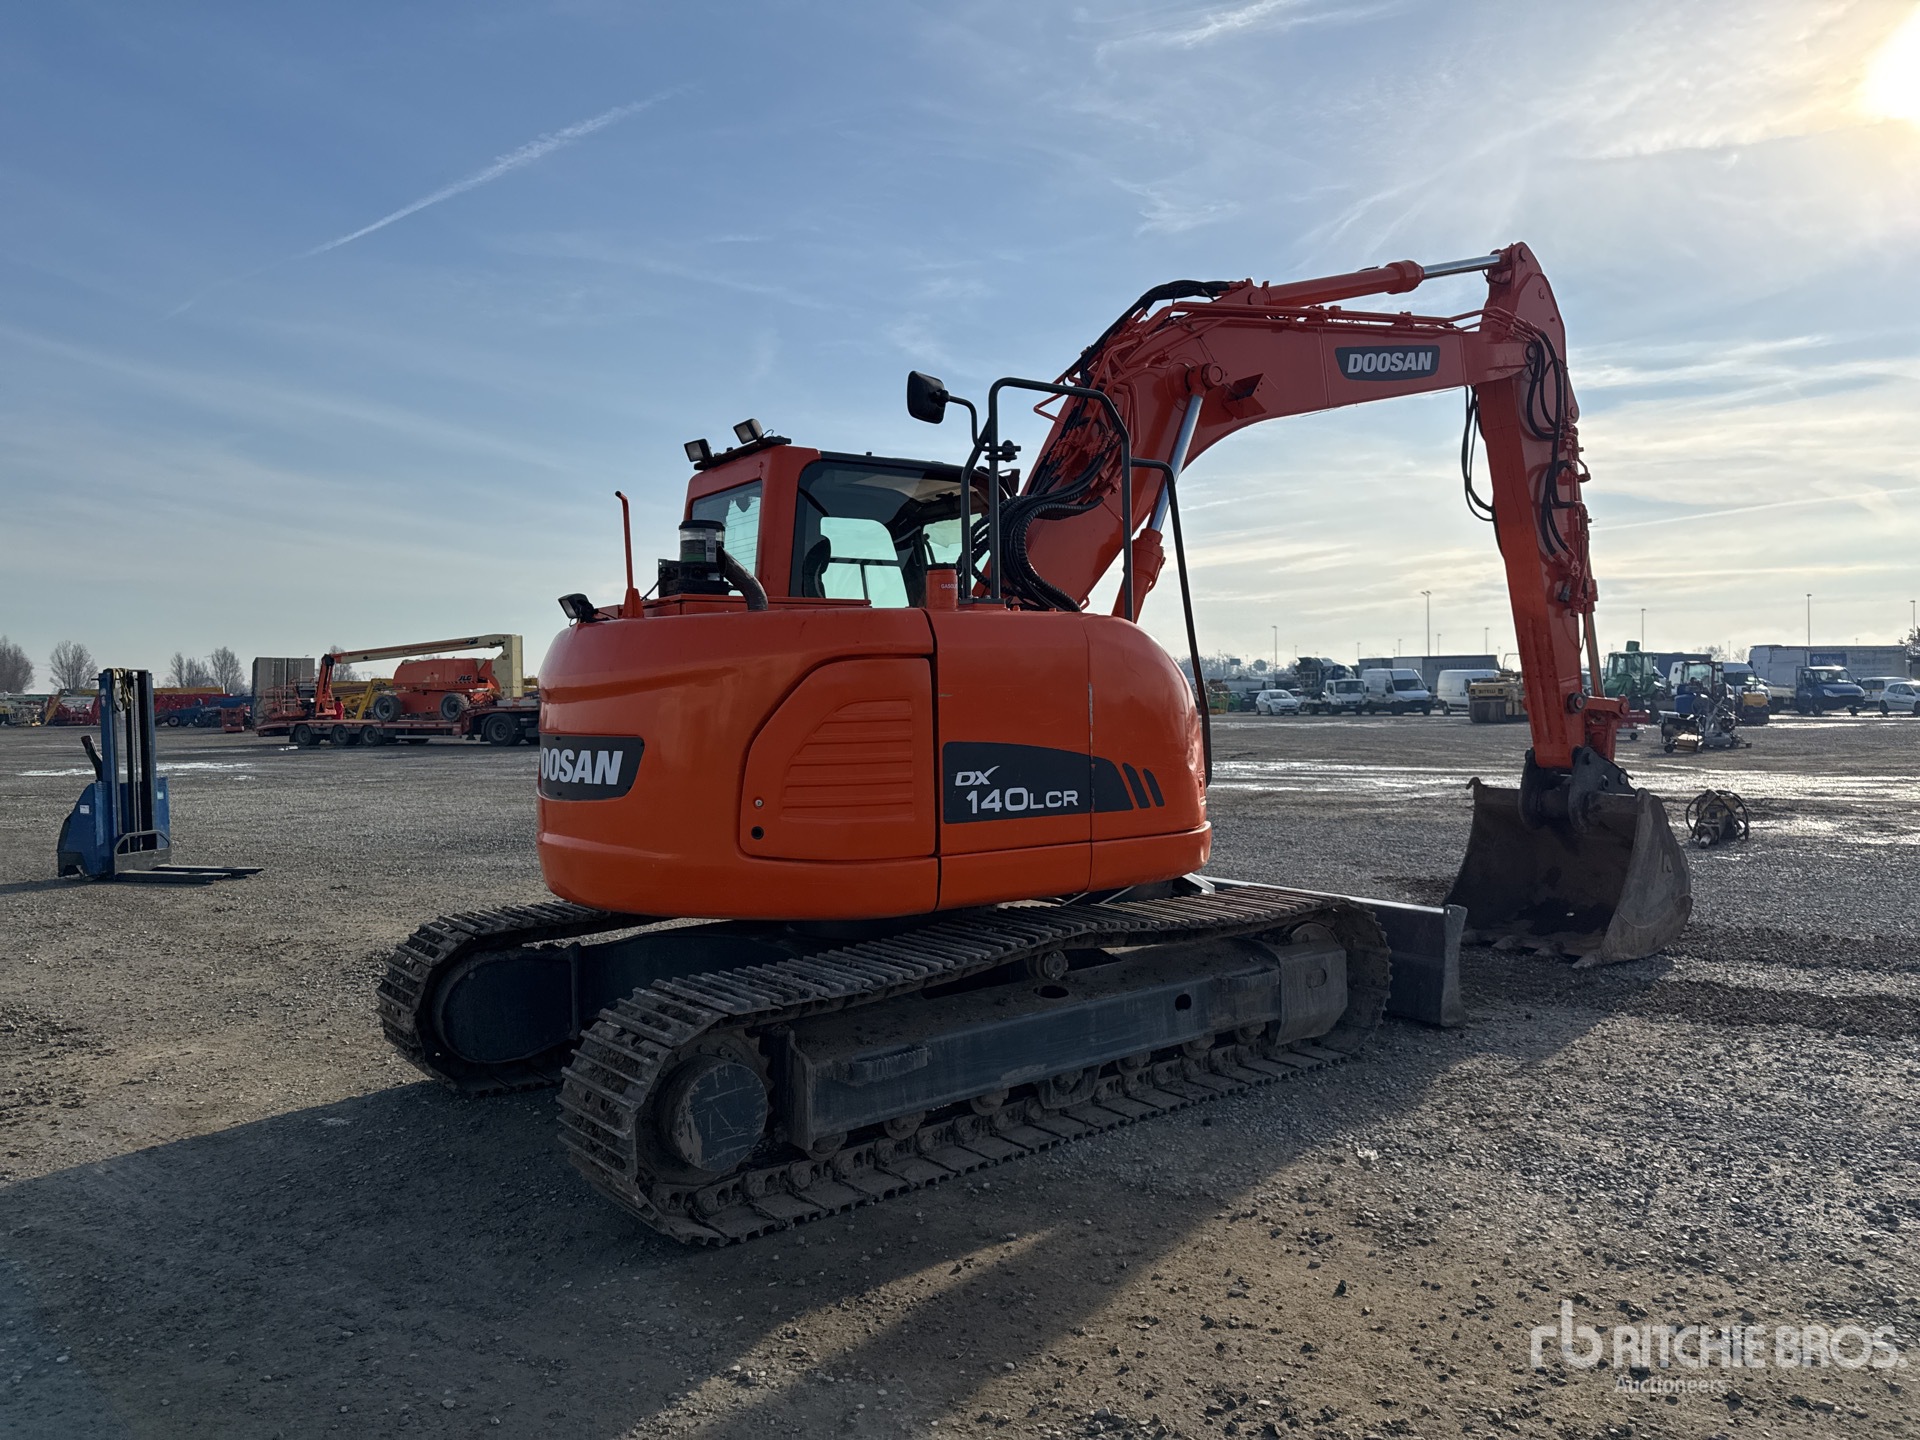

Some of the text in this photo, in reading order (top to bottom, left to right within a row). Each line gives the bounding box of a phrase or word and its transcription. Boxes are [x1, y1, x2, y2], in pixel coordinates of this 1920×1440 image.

[1347, 352, 1433, 374] DOOSAN
[540, 747, 623, 785] OOSAN
[955, 765, 1000, 787] DX
